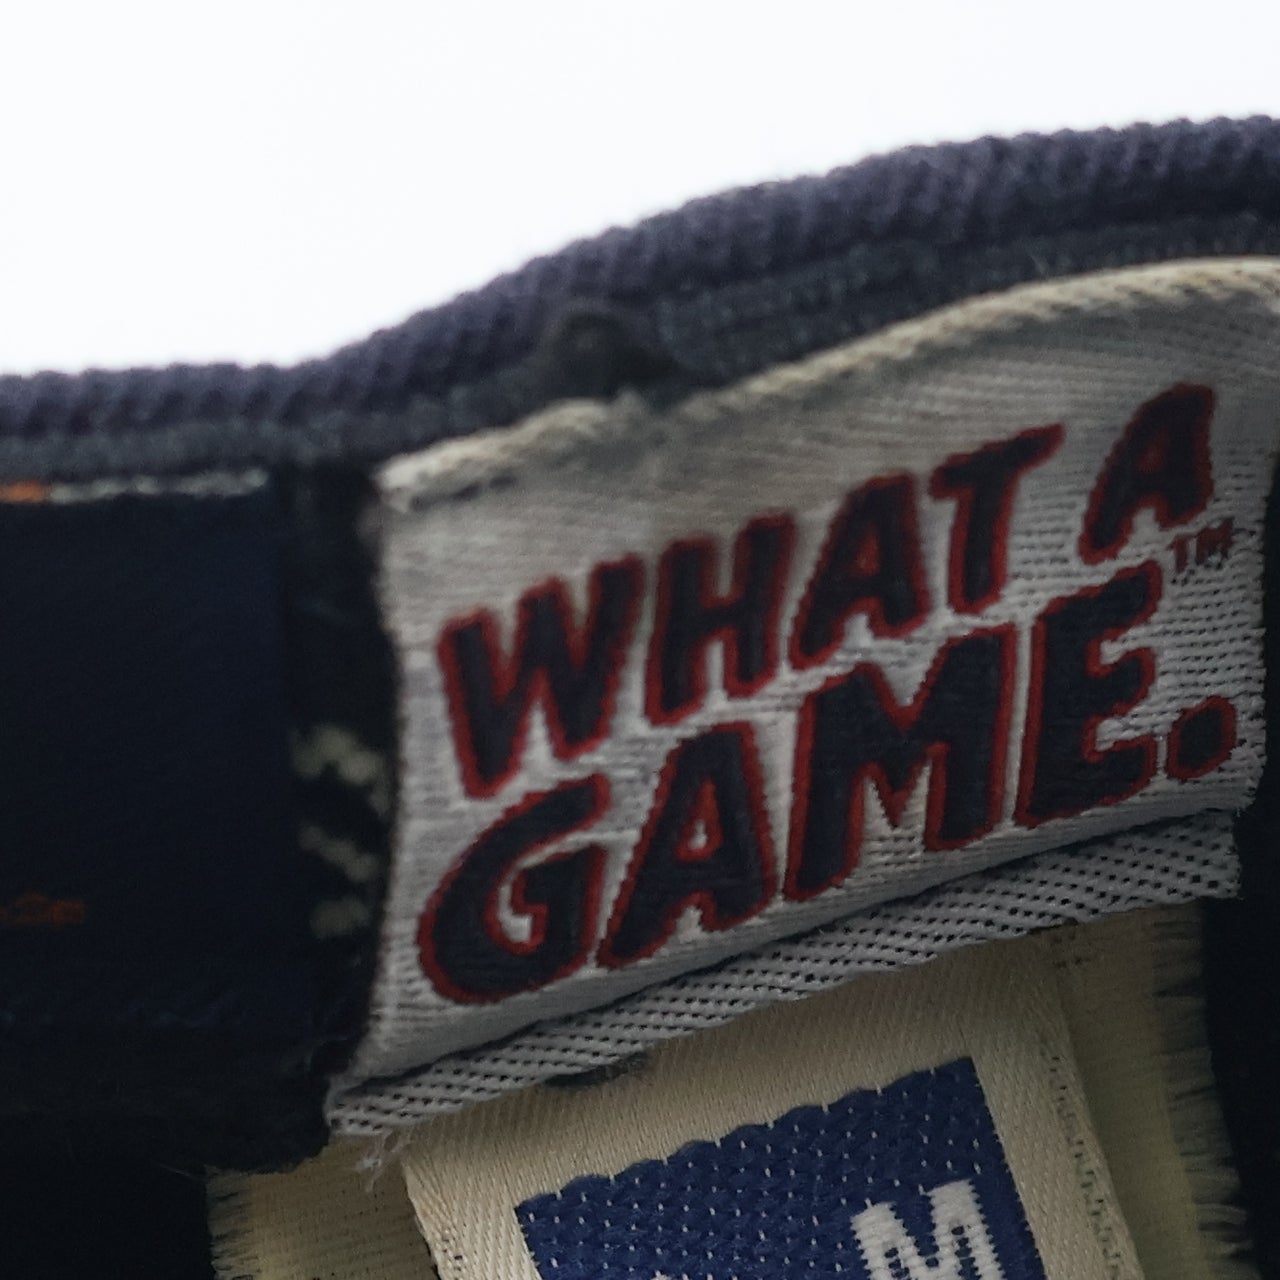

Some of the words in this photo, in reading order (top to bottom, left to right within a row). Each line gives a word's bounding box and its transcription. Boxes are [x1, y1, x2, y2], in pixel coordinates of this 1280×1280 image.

[415, 560, 1237, 1005] GAME.
[436, 422, 1065, 799] WHAT
[1077, 382, 1216, 564] A
